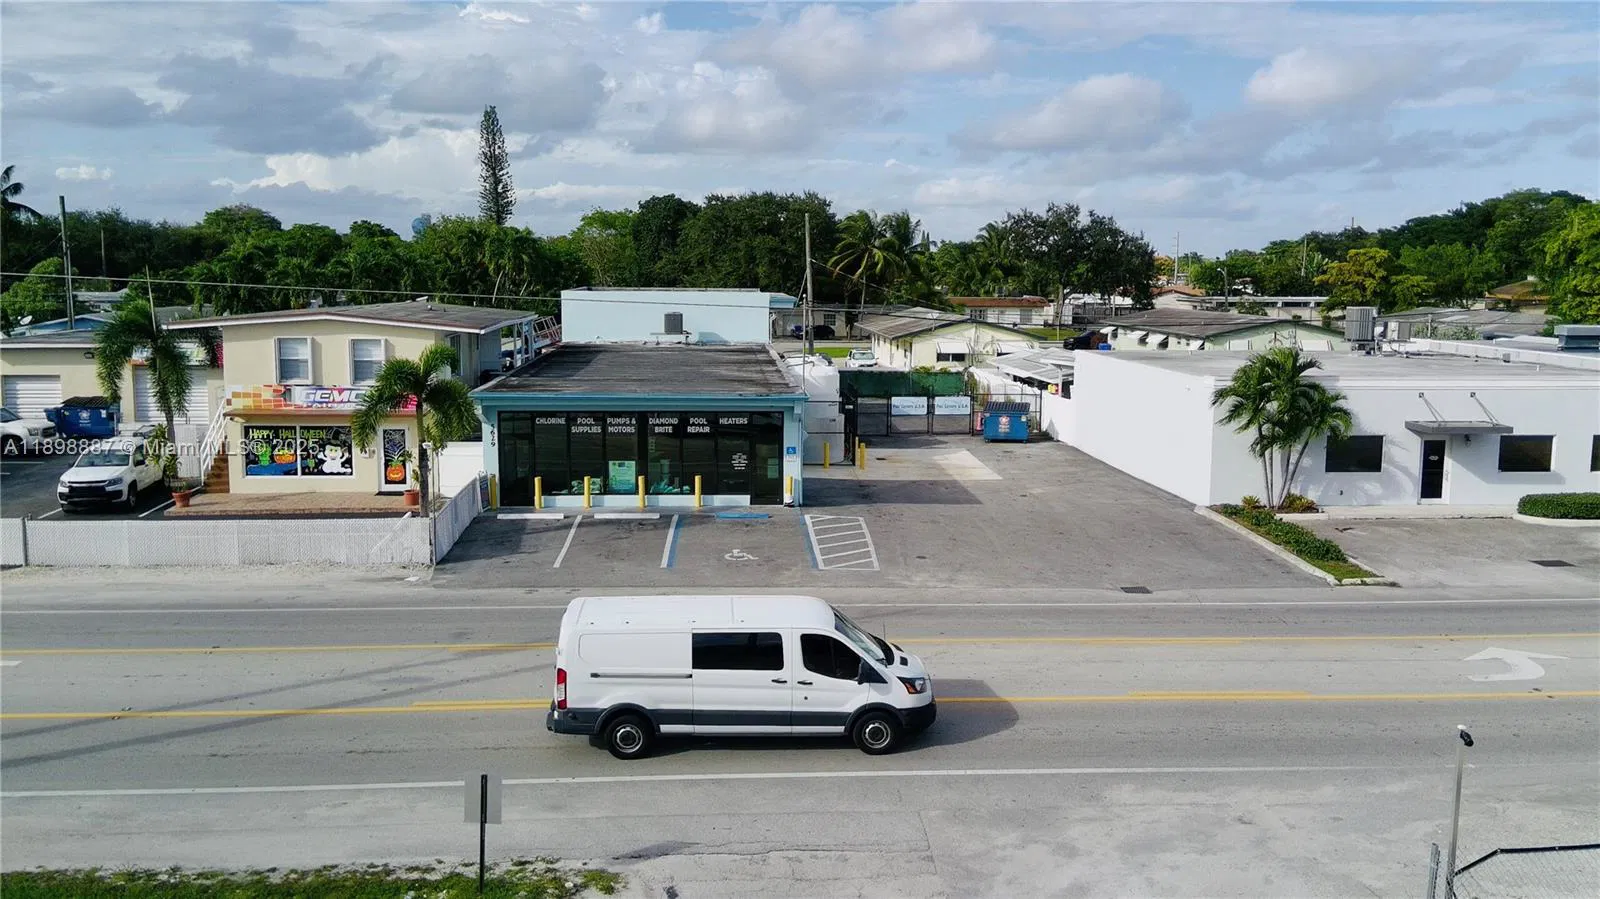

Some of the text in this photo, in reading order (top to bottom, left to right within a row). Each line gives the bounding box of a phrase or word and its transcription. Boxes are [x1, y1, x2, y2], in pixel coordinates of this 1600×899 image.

[535, 417, 566, 425] CHLORINE
[577, 417, 595, 425] POOL
[606, 417, 636, 425] PUMPS &
[648, 417, 678, 425] DIAMOND
[689, 417, 708, 425] POOL
[719, 417, 748, 425] HEATERS
[249, 428, 274, 439] HAPPY
